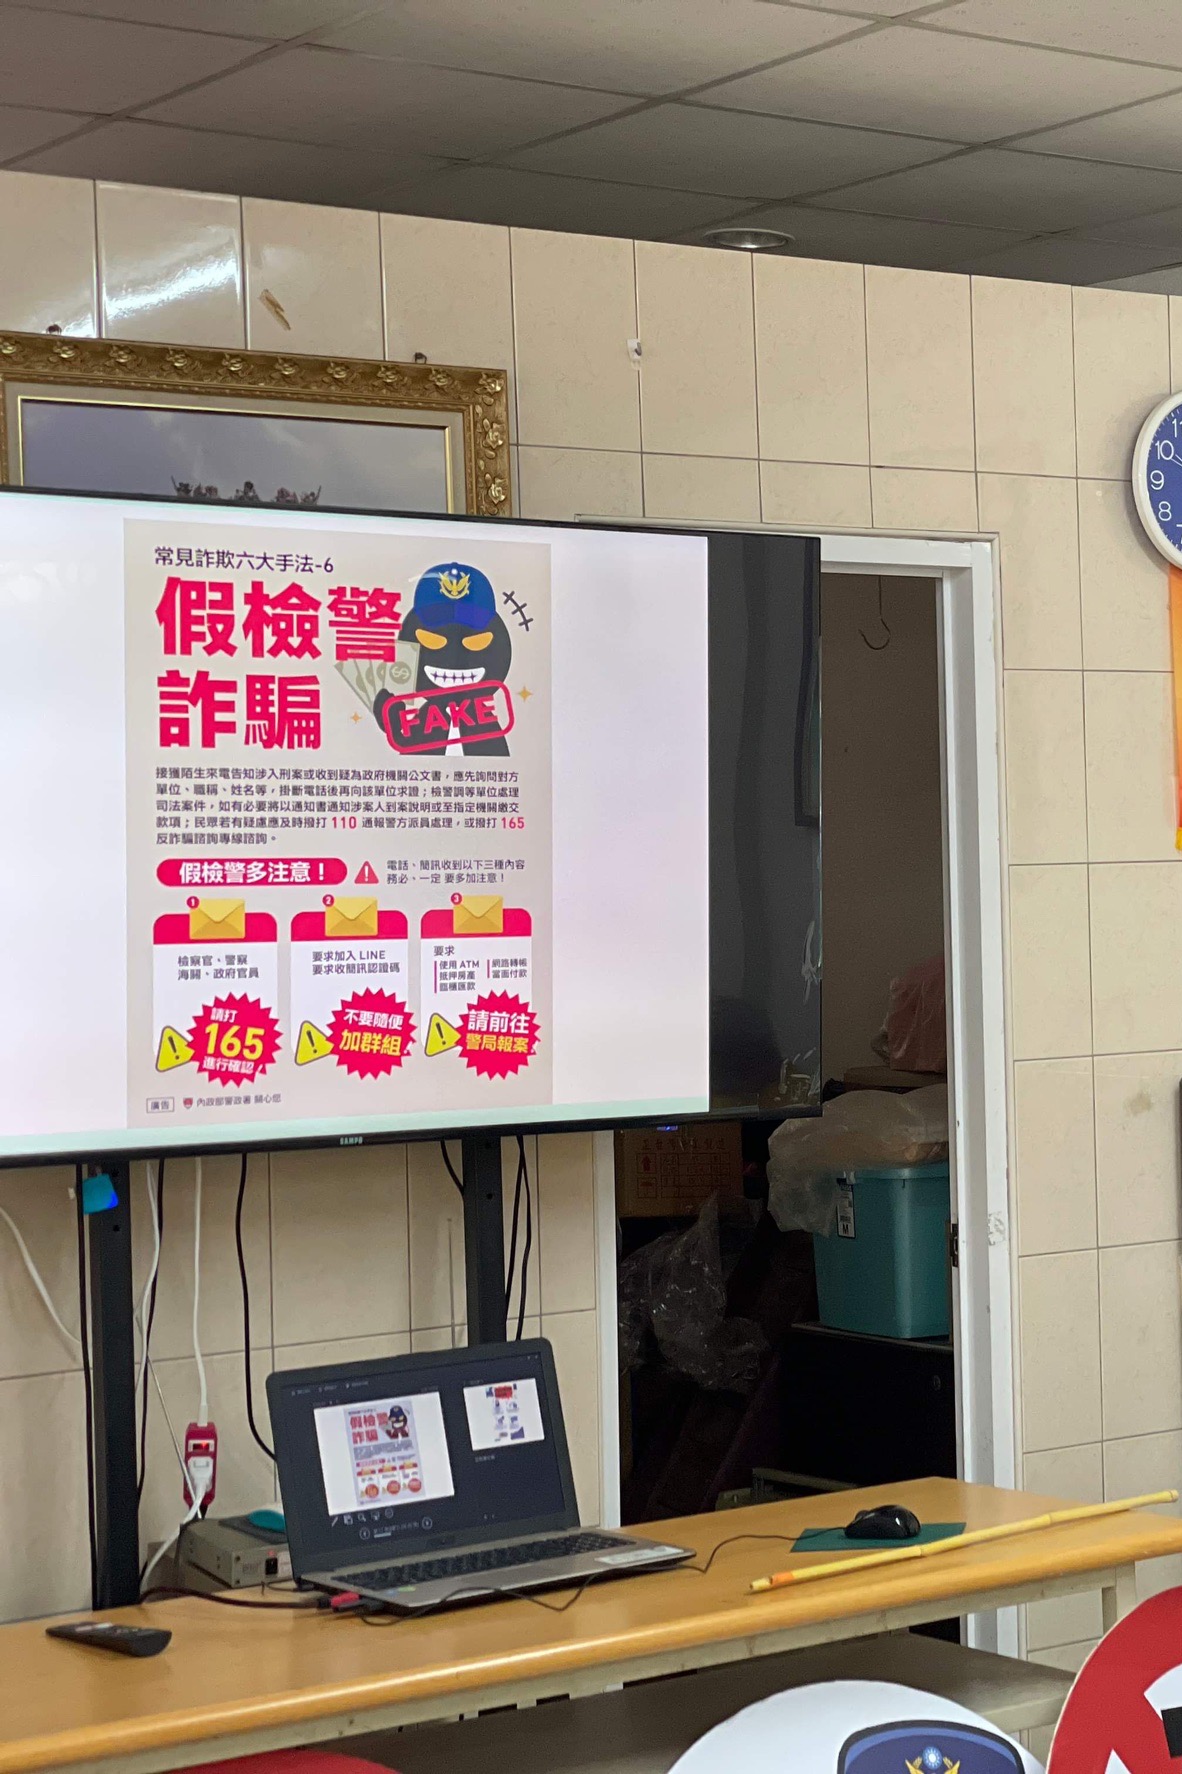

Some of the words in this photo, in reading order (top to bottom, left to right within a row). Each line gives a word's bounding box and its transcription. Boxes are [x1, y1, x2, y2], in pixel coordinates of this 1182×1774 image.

[1155, 440, 1174, 461] 10
[1150, 470, 1165, 490] 9
[1158, 501, 1172, 522] 8
[154, 546, 334, 574] 常見詐欺六大手法-6
[155, 576, 402, 662] 假檢警
[157, 670, 321, 750] 詐騙
[400, 695, 499, 738] FAKE
[332, 816, 357, 829] 110
[501, 817, 525, 829] 165
[179, 860, 326, 884] 假檢警多注意！
[387, 859, 525, 871] 電話、簡訊收到以下三種內容
[312, 951, 356, 963] 要求加入
[359, 950, 386, 960] LINE
[433, 945, 455, 957] 要求
[312, 962, 400, 975] 要求收簡訊認證碼
[439, 960, 457, 970] 使用
[459, 960, 480, 968] ATM
[210, 1007, 237, 1023] 請打
[343, 1008, 404, 1030] 不要隨便
[467, 1009, 531, 1034] 請前往
[205, 1023, 265, 1061] 165
